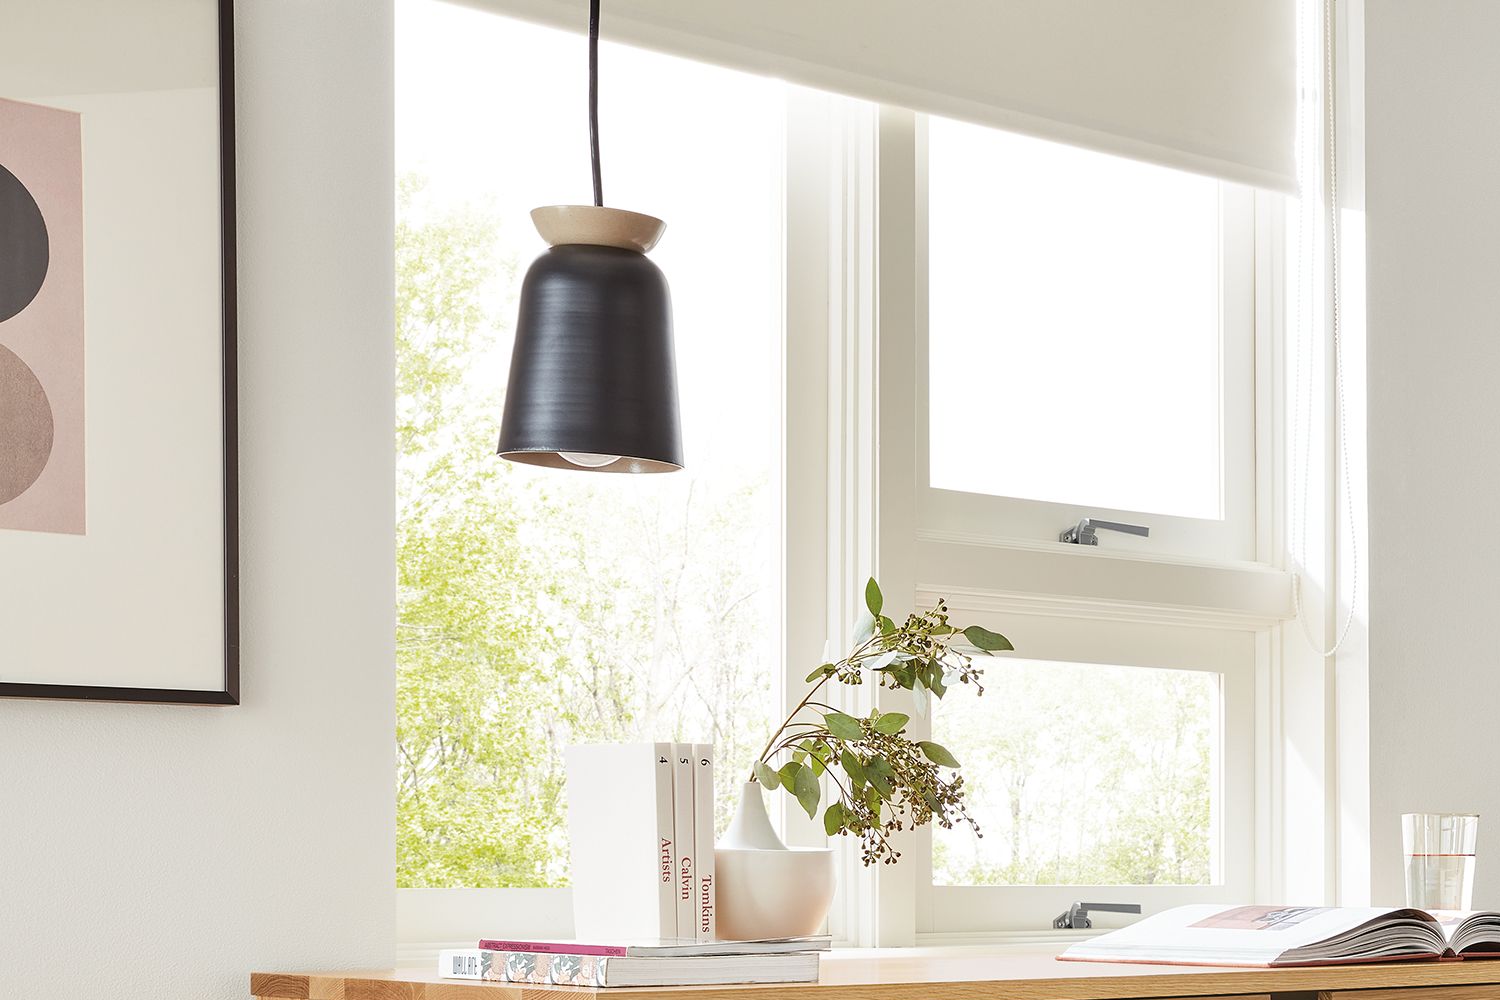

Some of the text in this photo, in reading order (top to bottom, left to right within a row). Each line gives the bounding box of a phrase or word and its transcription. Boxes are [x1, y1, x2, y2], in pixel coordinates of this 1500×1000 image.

[659, 756, 668, 764] 4
[700, 758, 711, 766] 6
[661, 838, 673, 883] Artists
[681, 856, 692, 900] Calvin
[702, 874, 713, 933] Tomkins
[453, 956, 478, 976] WALL ART
